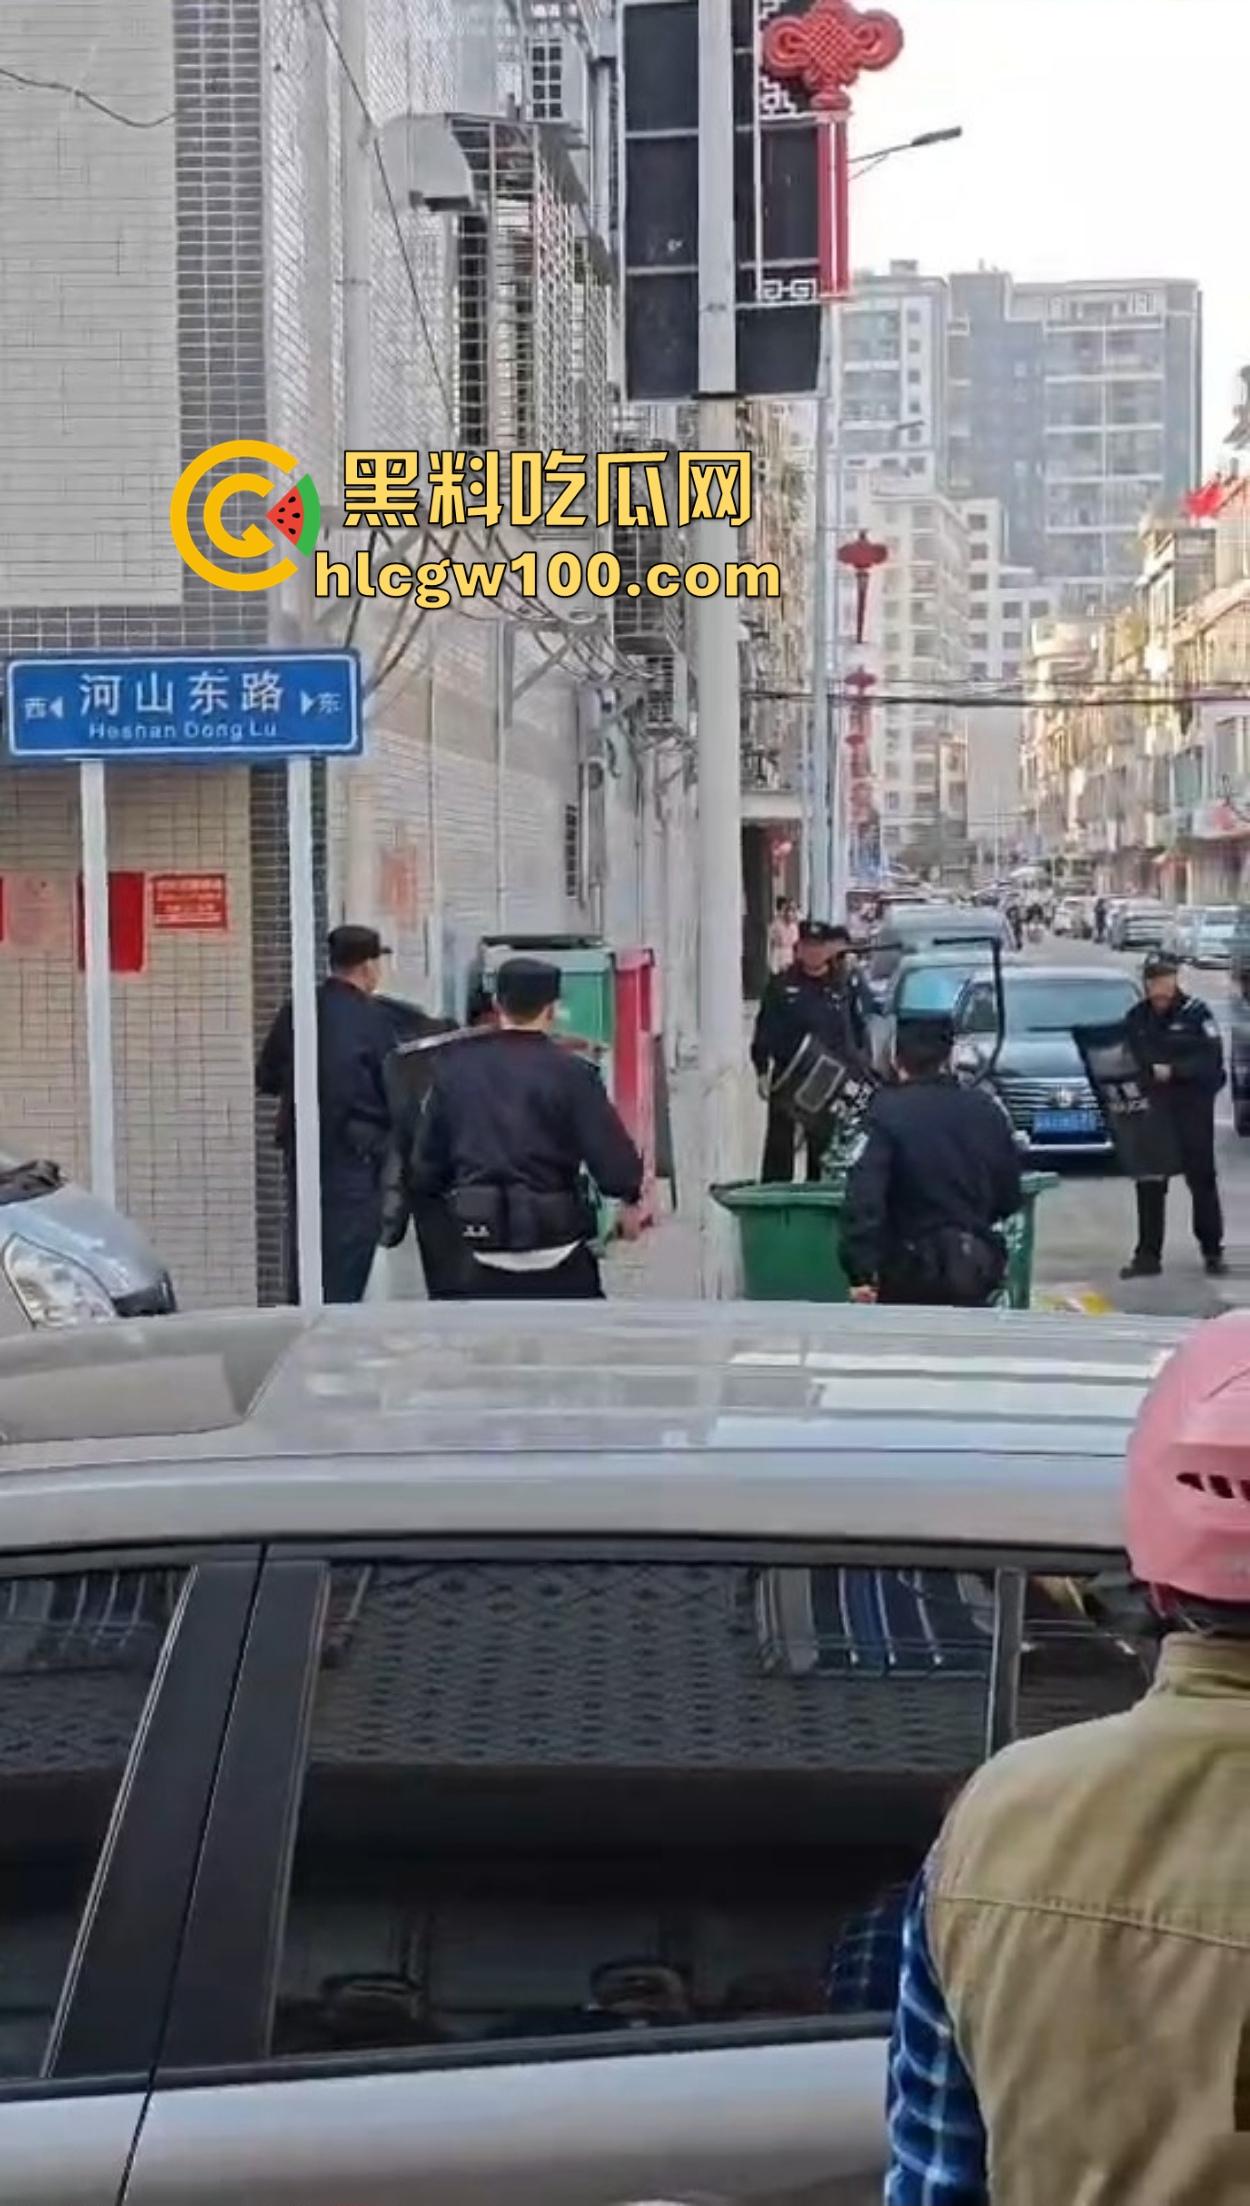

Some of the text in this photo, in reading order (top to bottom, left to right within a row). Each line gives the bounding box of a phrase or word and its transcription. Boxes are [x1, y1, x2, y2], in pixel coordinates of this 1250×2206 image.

[79, 670, 284, 716] 河山东路
[316, 692, 342, 715] 东
[24, 697, 48, 721] 西
[184, 721, 242, 741] Dong
[249, 719, 278, 738] Lu
